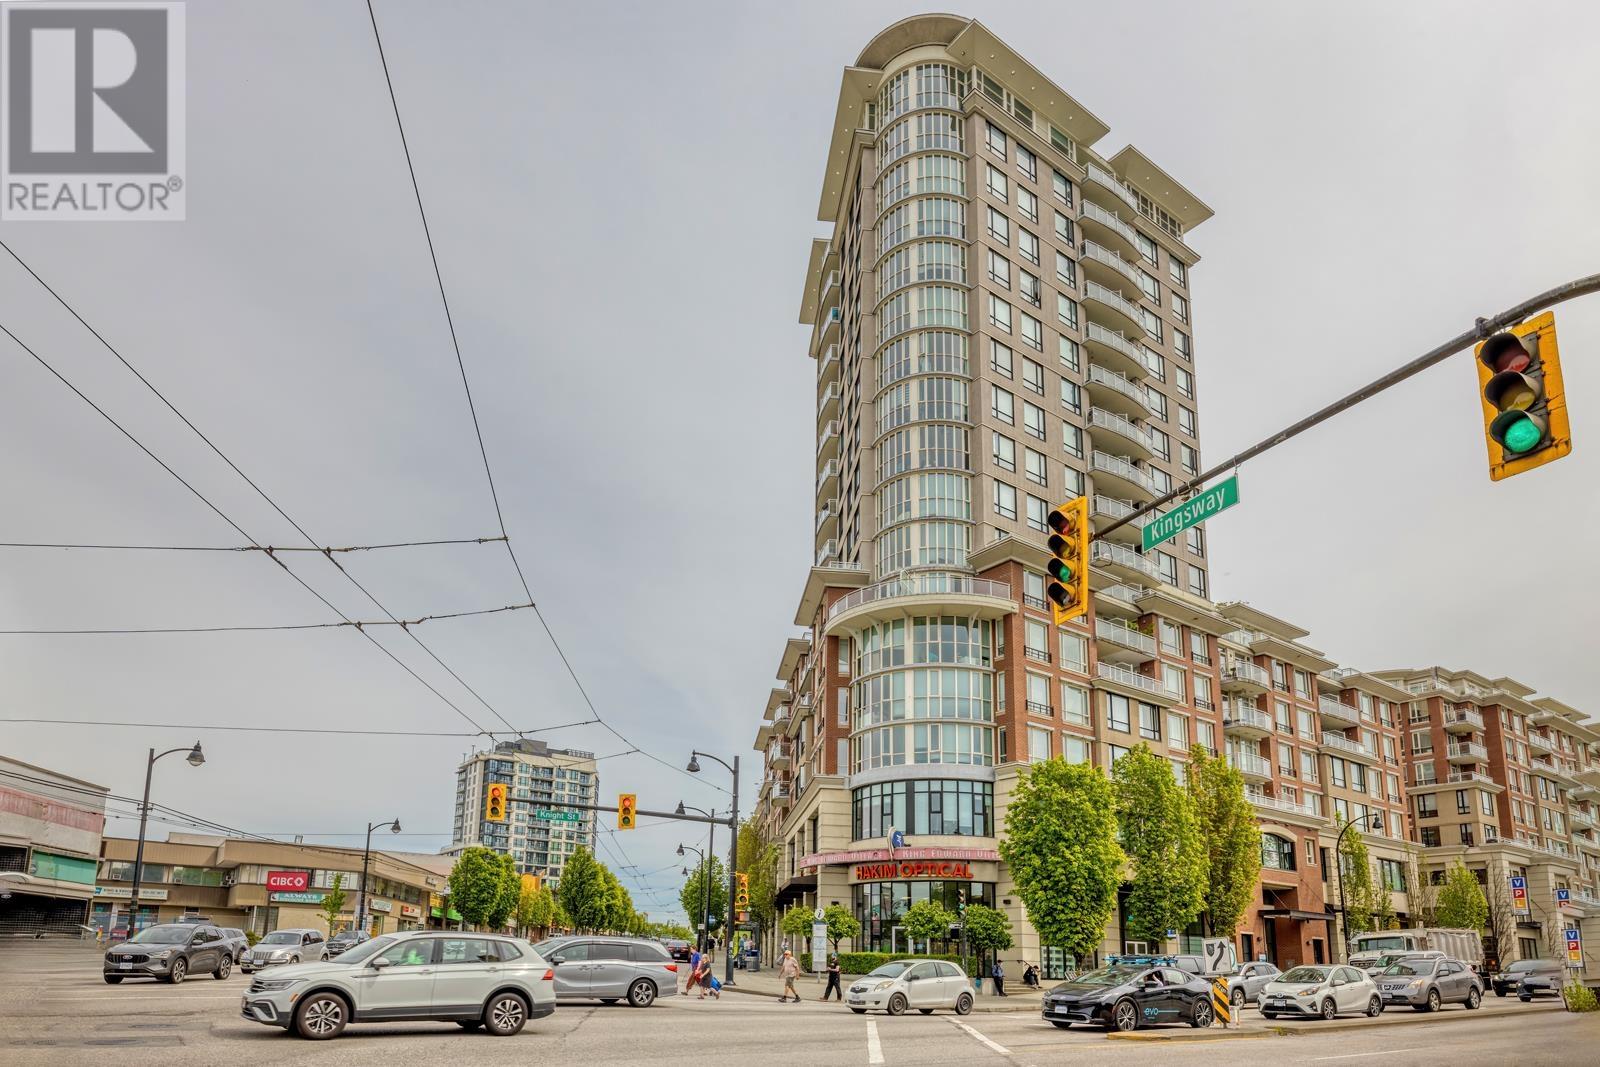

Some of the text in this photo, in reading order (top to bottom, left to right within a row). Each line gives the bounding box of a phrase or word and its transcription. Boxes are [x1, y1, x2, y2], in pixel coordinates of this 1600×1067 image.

[1151, 488, 1225, 542] Kingsway
[541, 810, 564, 819] Knight
[856, 862, 974, 880] HAKIM OPTICAL
[270, 877, 293, 886] CIBC
[1144, 1007, 1159, 1015] evo
